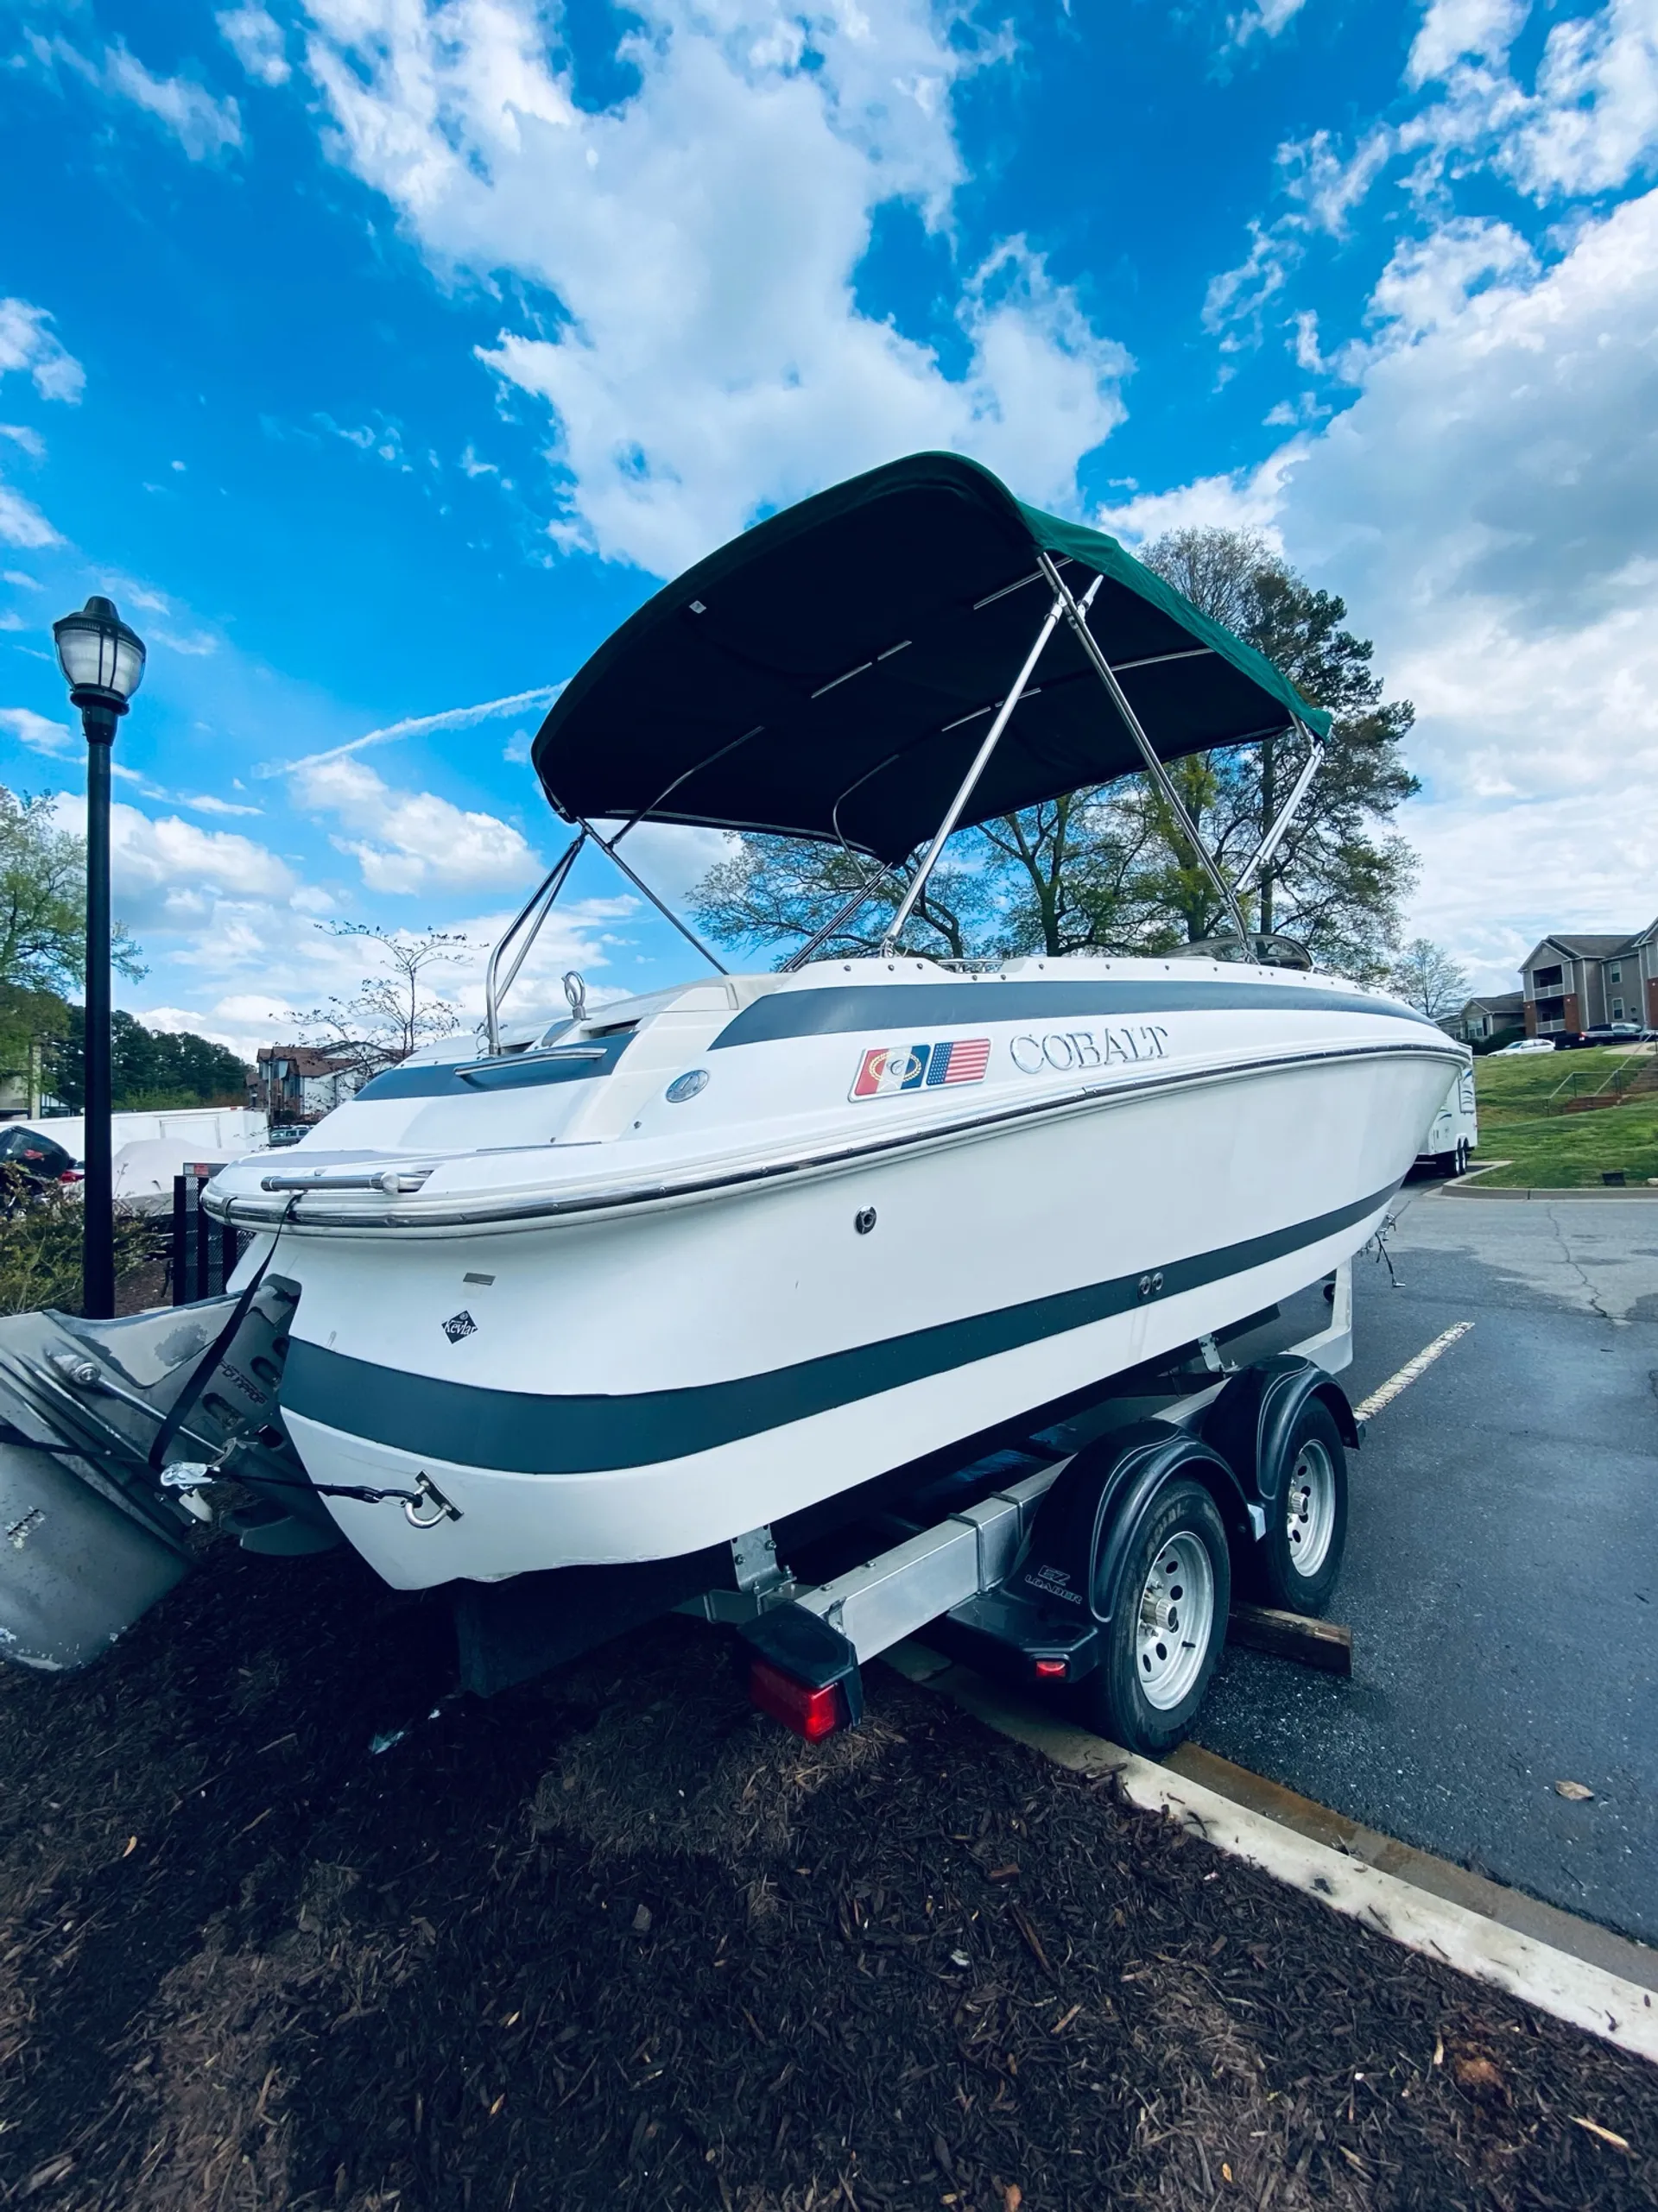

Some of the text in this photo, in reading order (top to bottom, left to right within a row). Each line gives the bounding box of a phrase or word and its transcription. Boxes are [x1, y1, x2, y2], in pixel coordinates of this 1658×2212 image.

[1009, 1026, 1168, 1074] COBALT
[444, 1319, 478, 1336] Kevlar
[1038, 1564, 1071, 1586] EZ
[1024, 1574, 1083, 1605] LOADER
